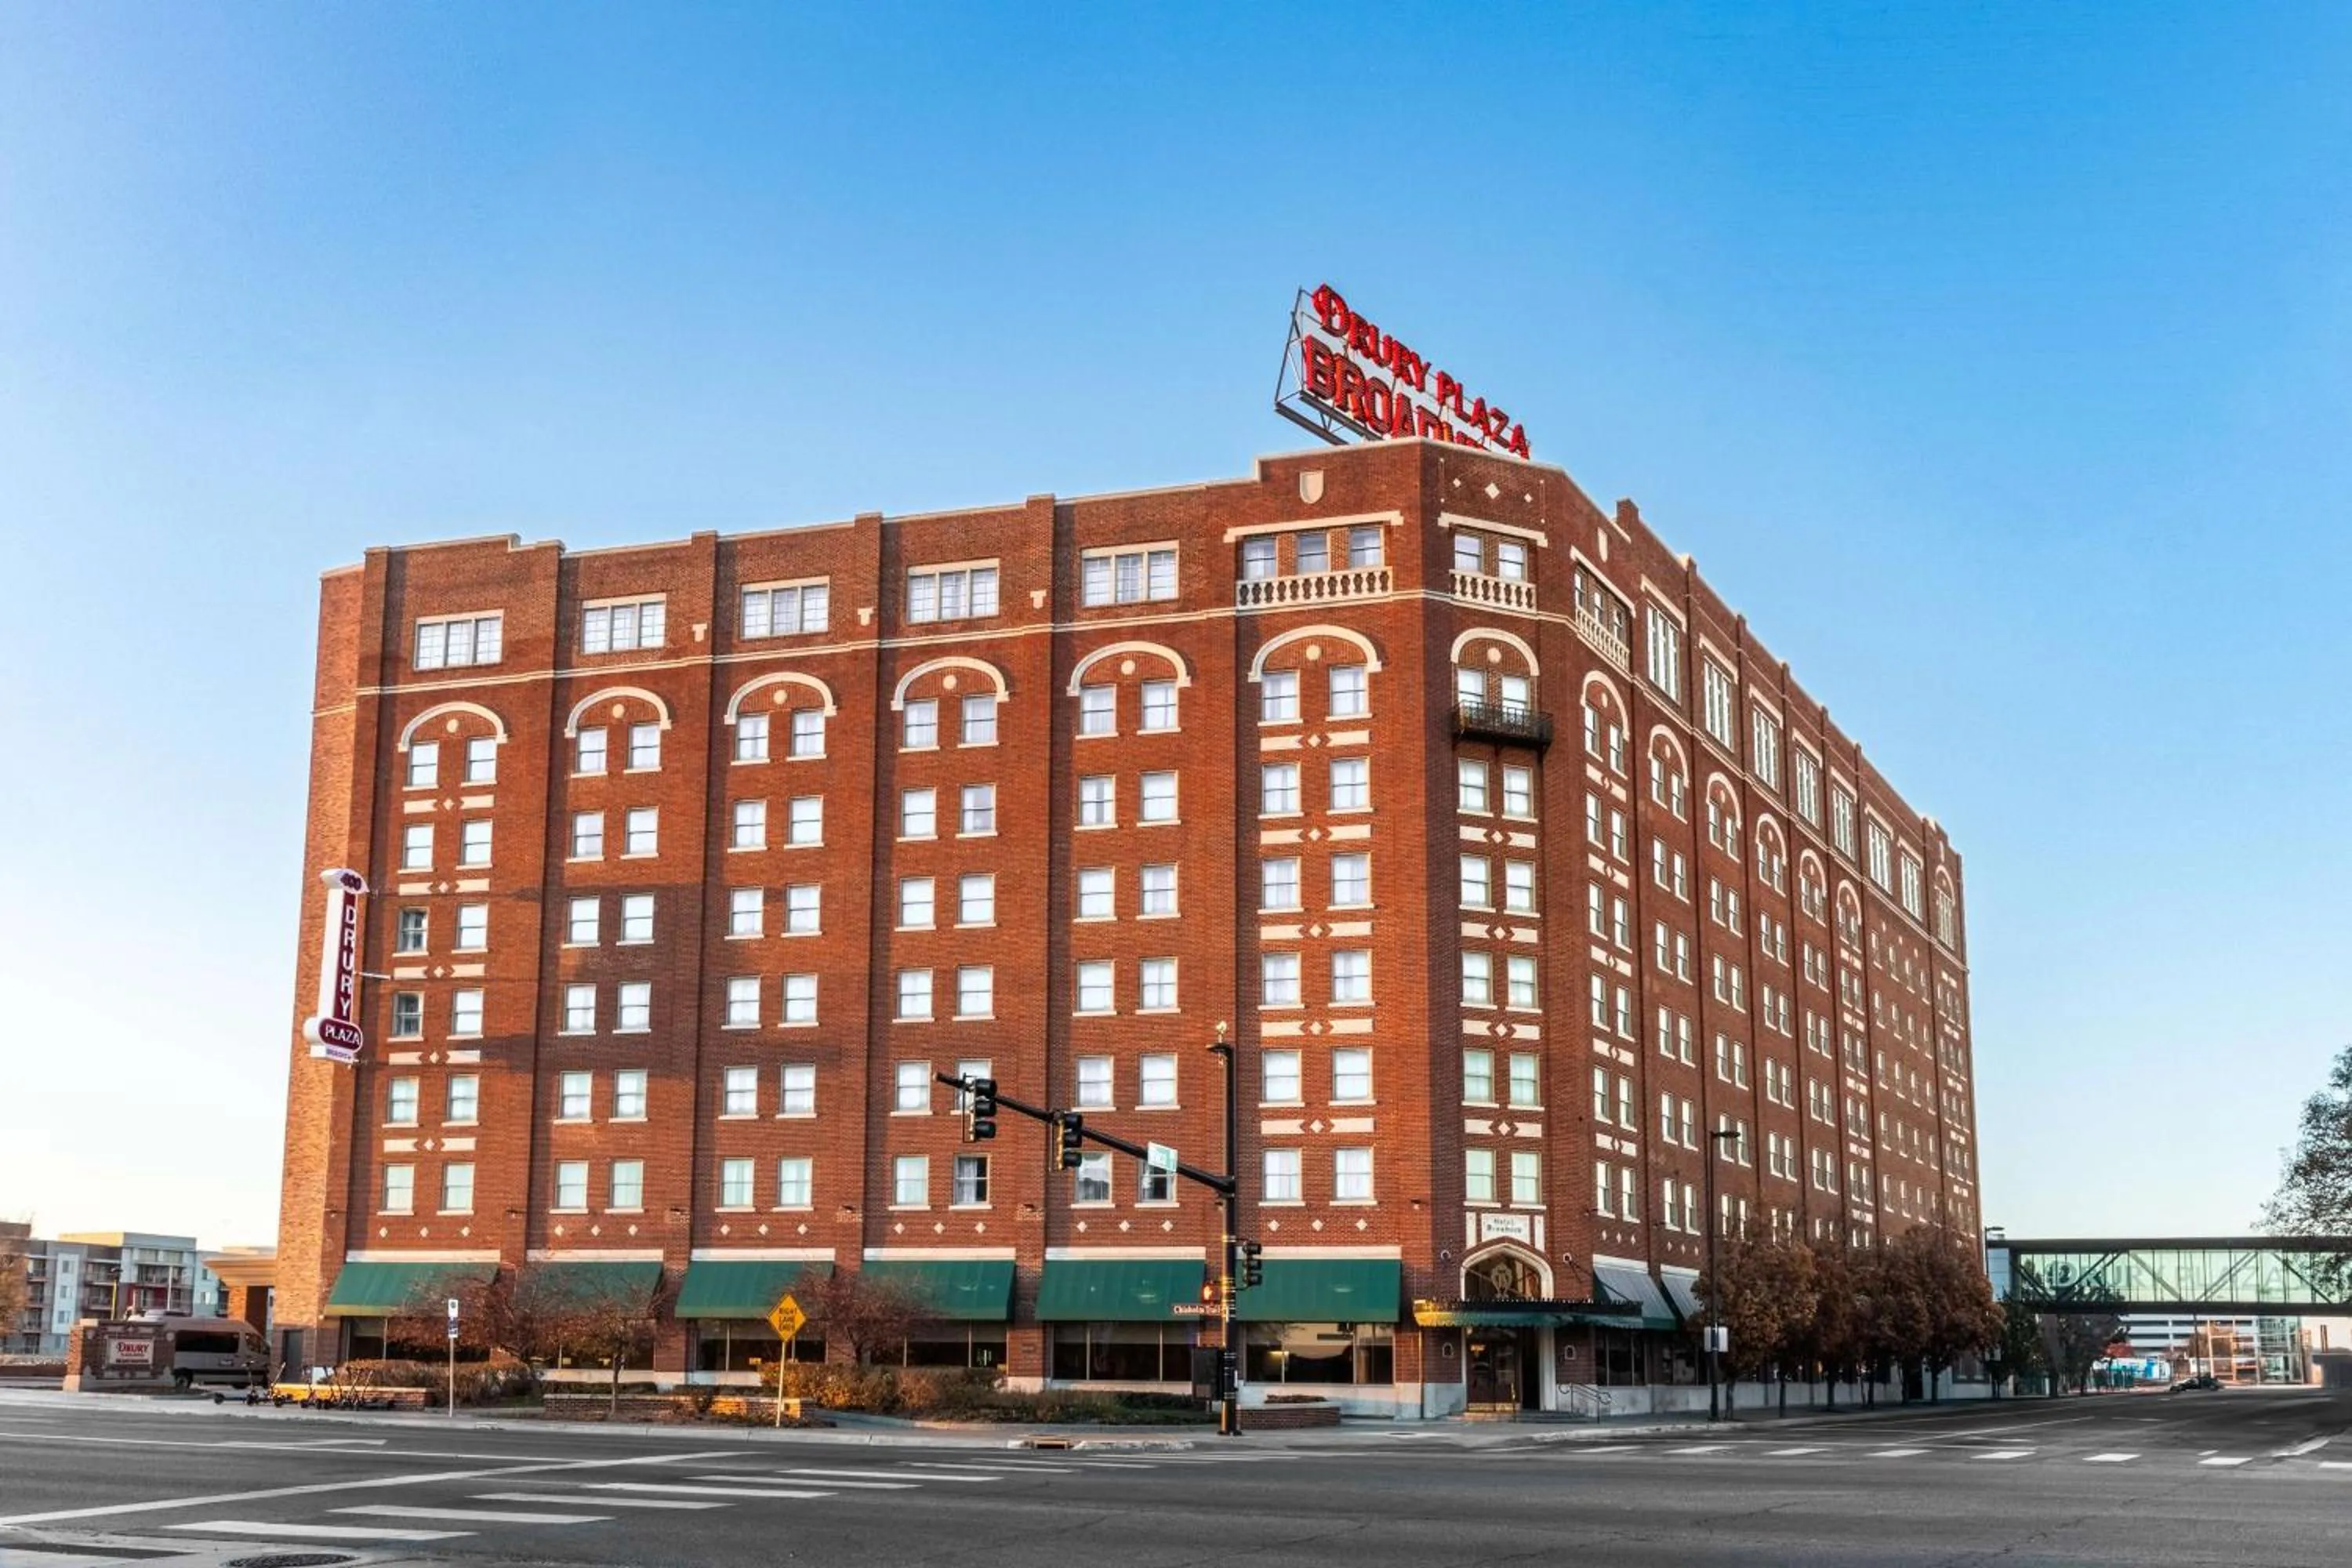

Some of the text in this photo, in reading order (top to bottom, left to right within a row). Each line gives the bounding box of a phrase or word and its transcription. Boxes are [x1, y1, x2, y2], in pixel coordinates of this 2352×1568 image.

[1304, 333, 1485, 449] BROAD
[1312, 283, 1530, 459] DRURY PLAZA
[340, 904, 356, 1017] DRURY
[325, 1023, 360, 1046] PLAZA
